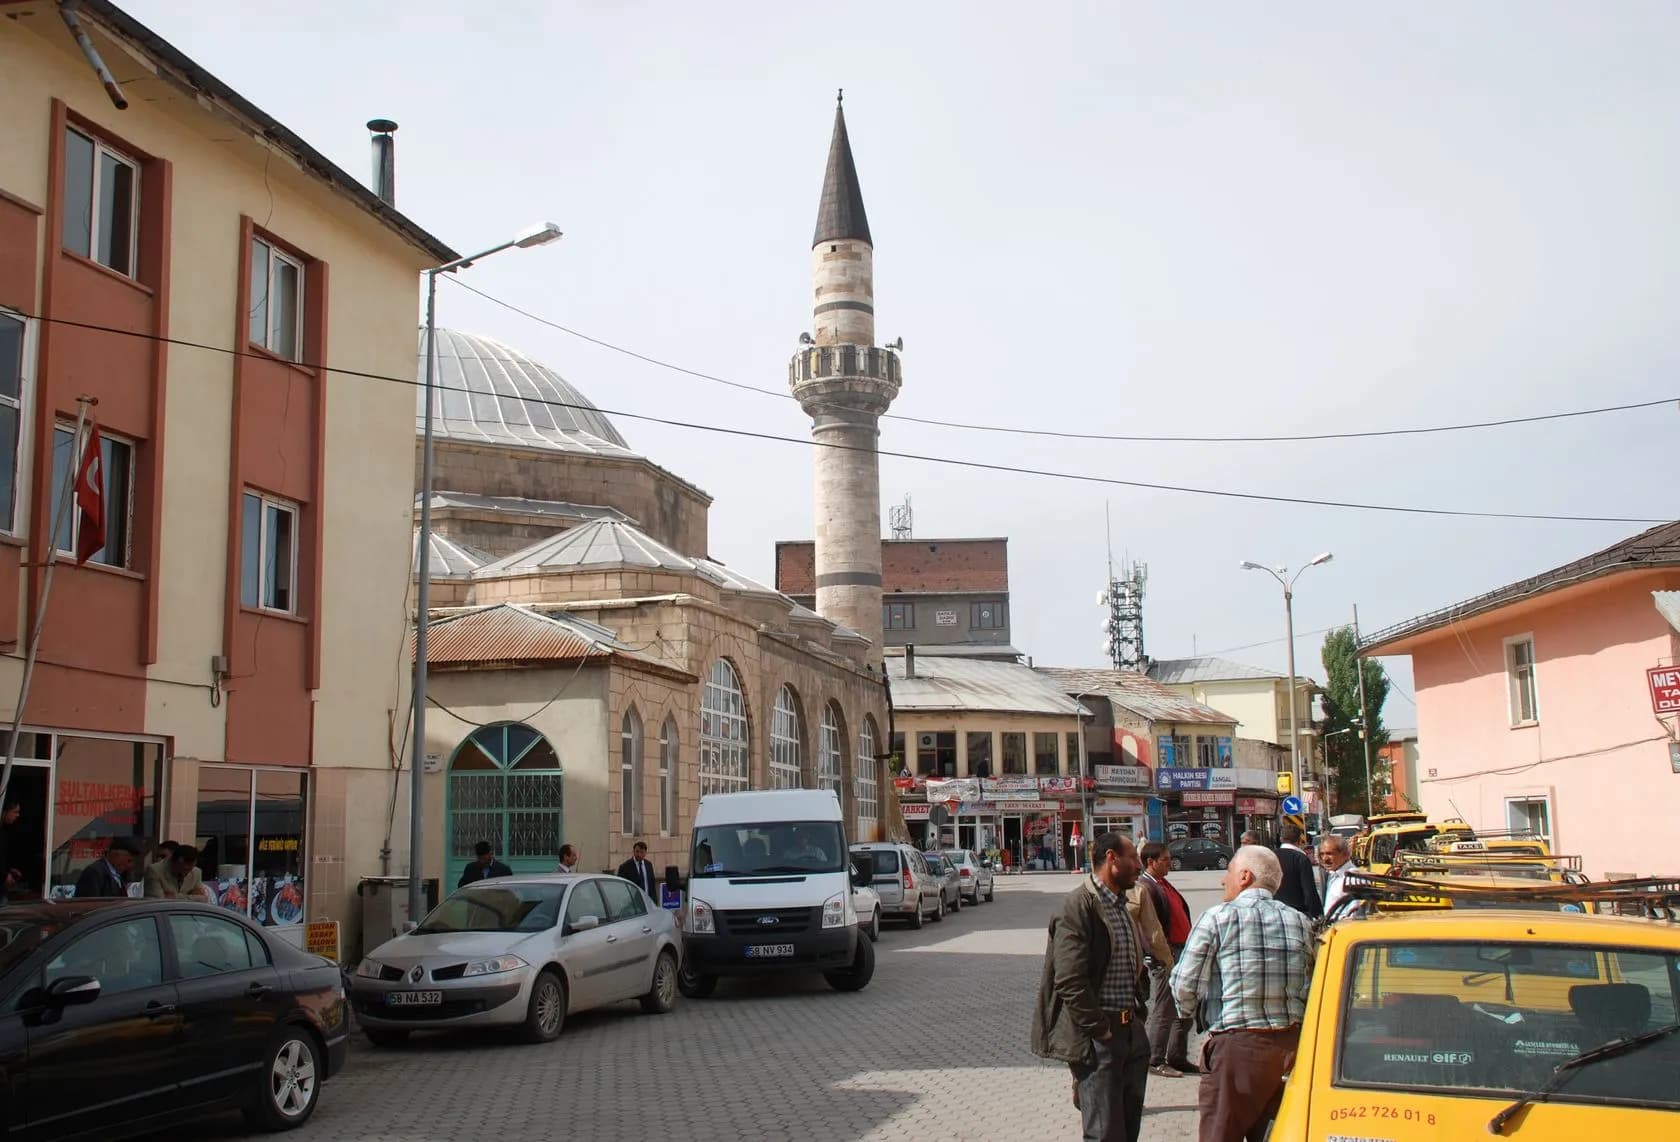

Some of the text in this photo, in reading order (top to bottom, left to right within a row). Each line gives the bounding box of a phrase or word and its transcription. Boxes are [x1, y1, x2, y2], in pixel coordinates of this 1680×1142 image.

[763, 946, 775, 955] NV
[777, 945, 792, 954] 934
[406, 992, 419, 1003] NA
[422, 992, 439, 1003] 532
[1384, 1053, 1457, 1063] RENAULT elf
[1330, 1106, 1436, 1126] 0542 726 01 8
